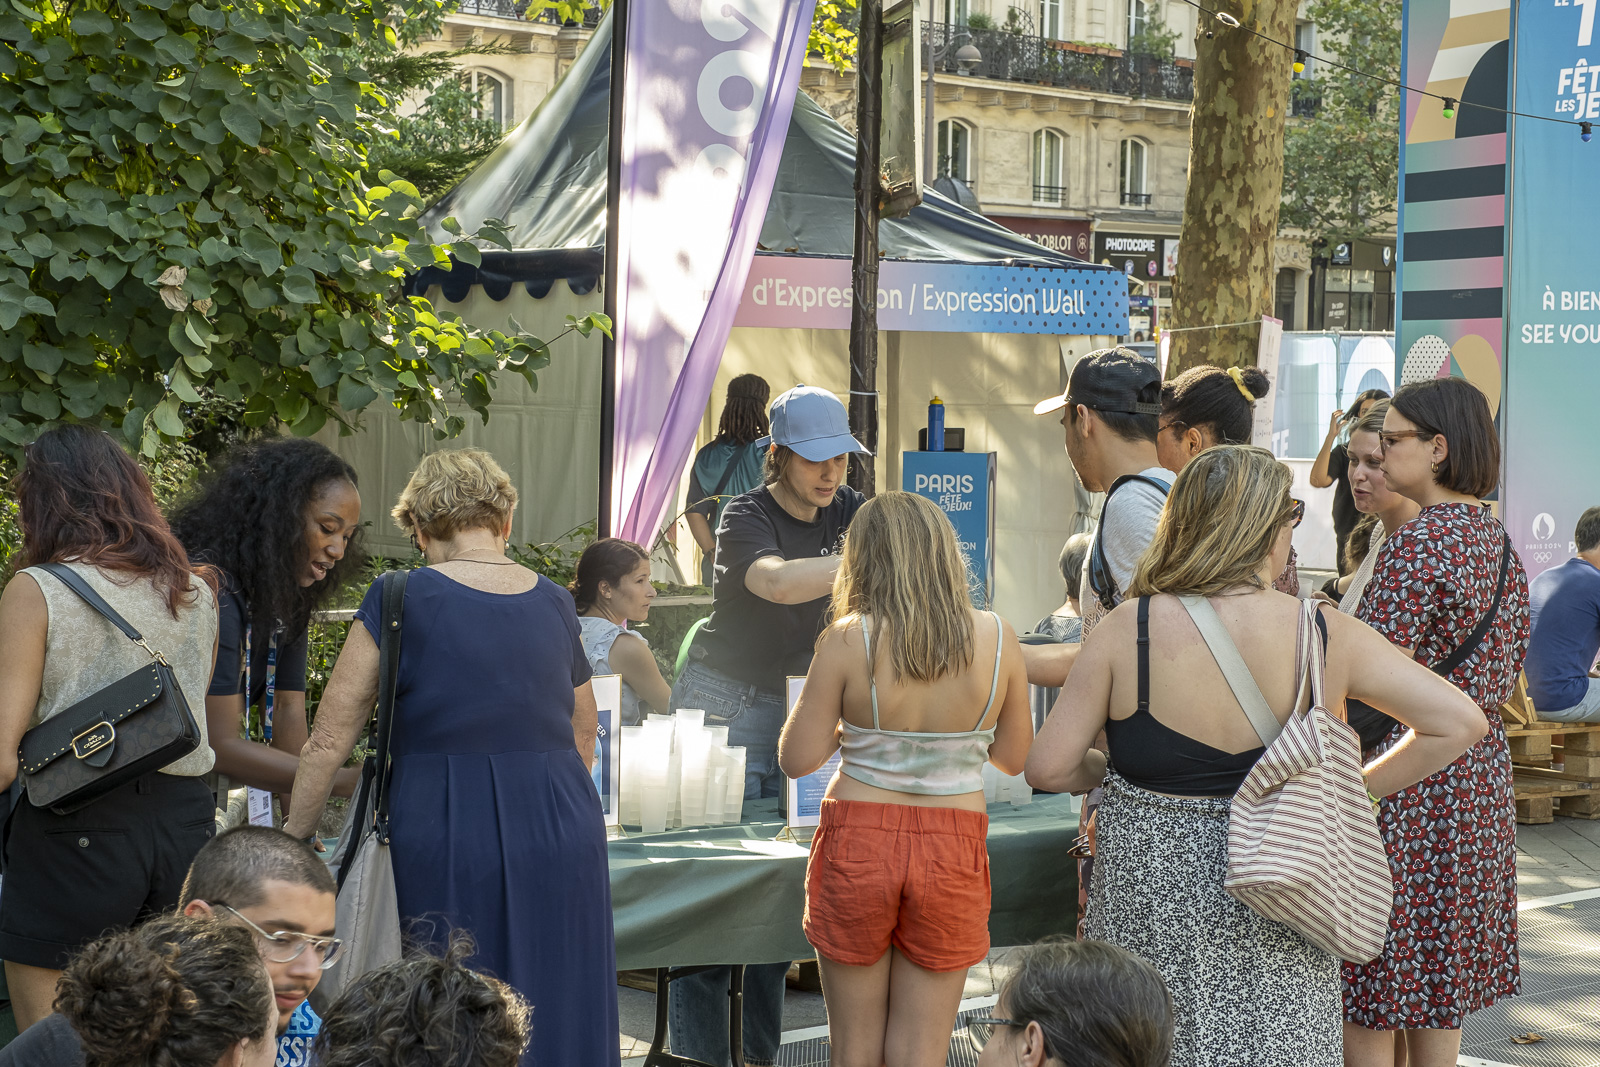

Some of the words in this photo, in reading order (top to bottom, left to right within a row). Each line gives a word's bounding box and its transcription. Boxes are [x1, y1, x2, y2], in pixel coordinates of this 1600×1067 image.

[1554, 99, 1576, 113] LES
[1105, 237, 1156, 252] PHOTOCOPIE
[923, 283, 1036, 317] Expression
[1042, 287, 1086, 315] Wall
[1542, 284, 1555, 311] À
[1521, 323, 1555, 344] SEE
[915, 474, 974, 493] PARIS
[939, 492, 962, 504] FÊTE
[945, 501, 972, 512] JEUX!
